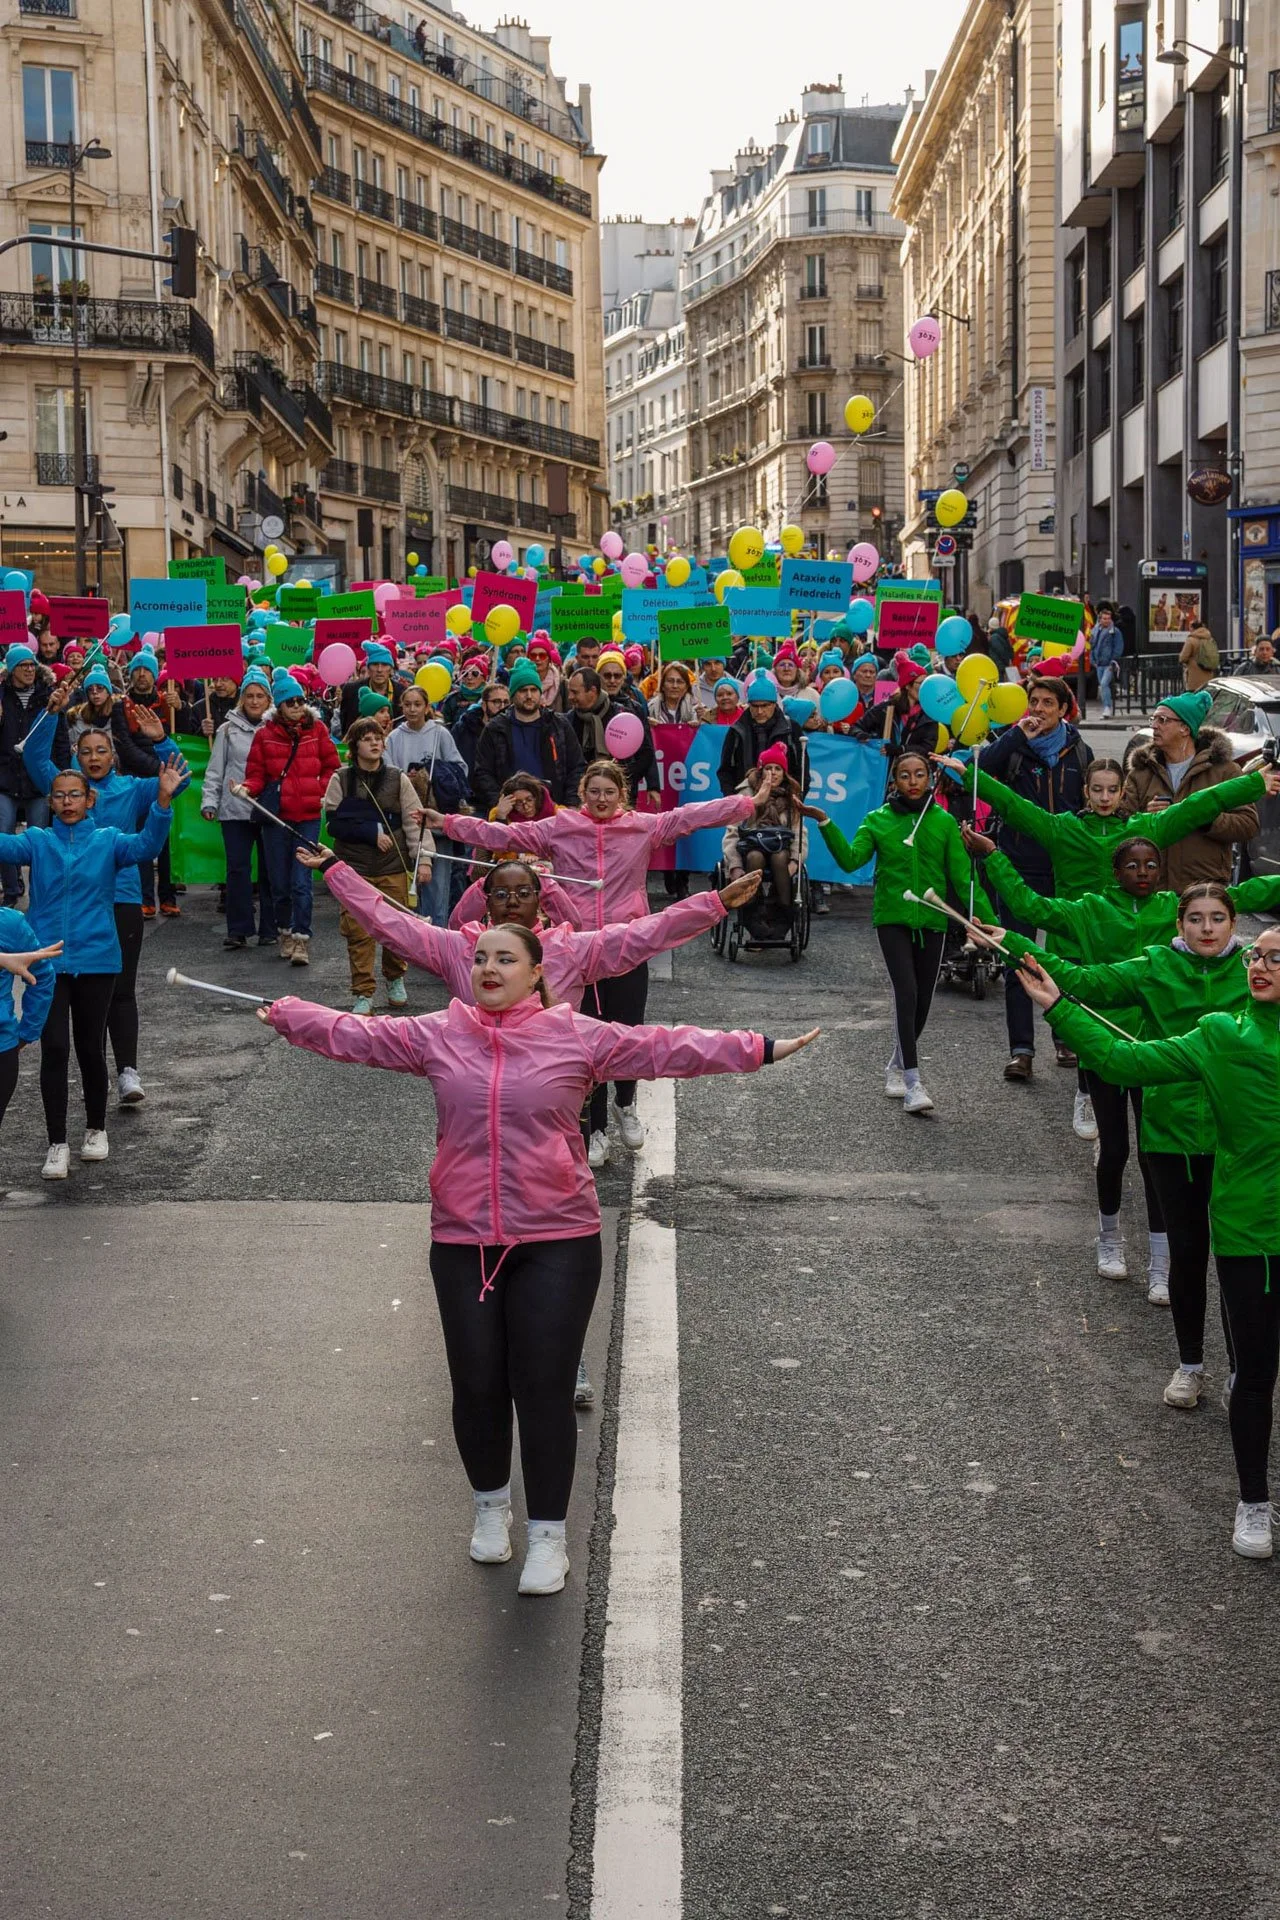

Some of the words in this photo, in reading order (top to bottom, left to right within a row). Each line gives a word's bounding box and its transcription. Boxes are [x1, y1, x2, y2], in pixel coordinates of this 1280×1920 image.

[792, 572, 826, 584] Ataxie
[828, 575, 842, 585] de
[482, 586, 528, 603] Syndrome
[789, 588, 842, 600] Friedreich
[134, 601, 203, 613] Acromégalie
[331, 603, 363, 615] Tumeur
[554, 607, 610, 617] Vascularites
[206, 611, 239, 620] DITAIRE
[391, 610, 427, 619] Maladie
[428, 610, 441, 619] de
[1025, 605, 1076, 622] Syndromes
[402, 624, 430, 632] Crohn
[660, 620, 713, 633] Syndrome
[715, 619, 729, 629] de
[681, 637, 710, 647] Lowe
[174, 647, 235, 659] Sarcoïdose
[280, 643, 306, 654] Uvéit
[655, 749, 711, 791] ies
